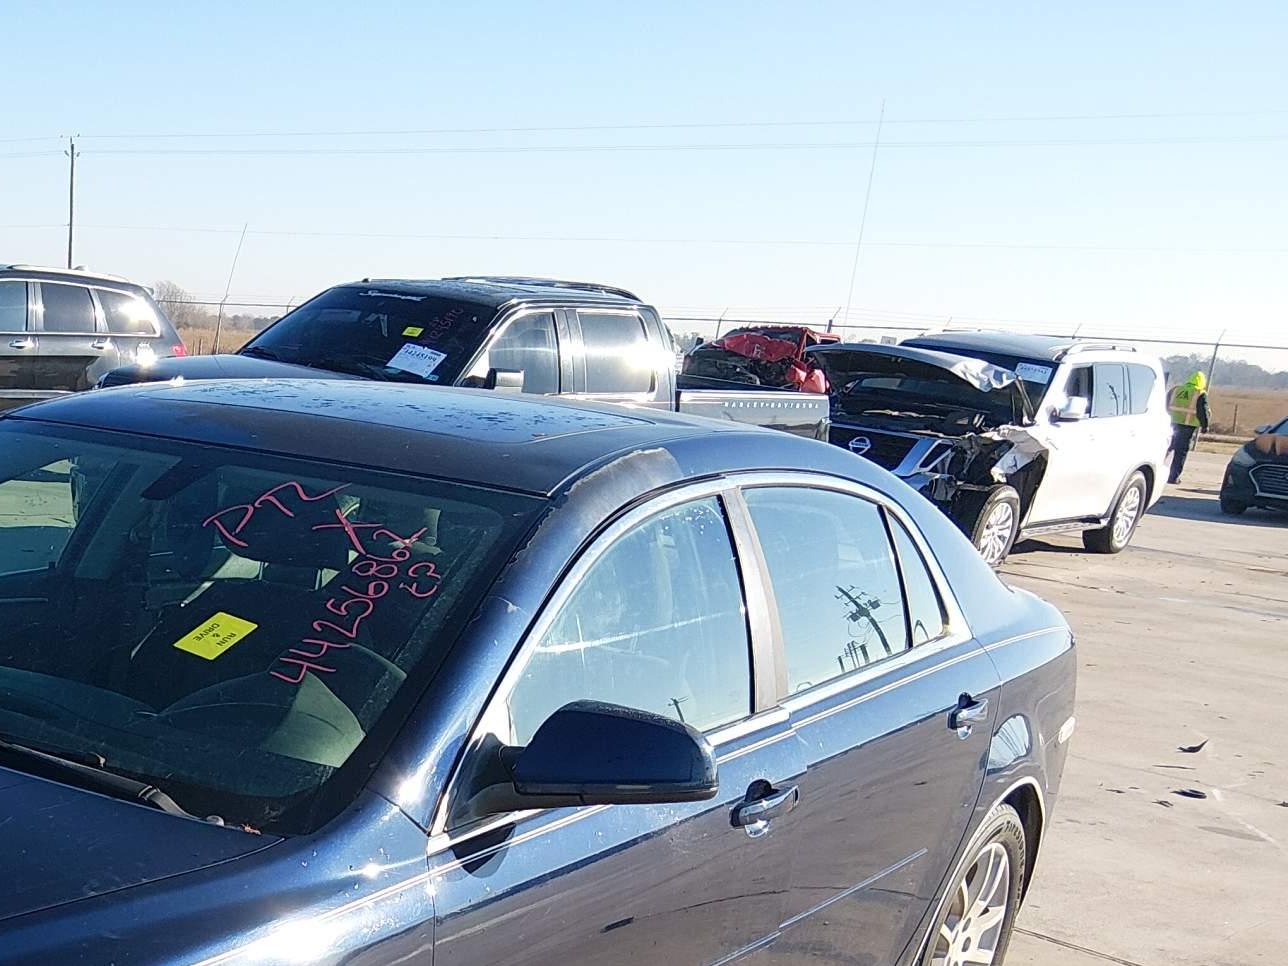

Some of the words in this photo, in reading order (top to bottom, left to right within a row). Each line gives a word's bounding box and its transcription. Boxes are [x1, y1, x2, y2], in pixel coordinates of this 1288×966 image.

[269, 526, 429, 684] 44256862
[192, 622, 221, 642] DRIVE
[215, 632, 237, 647] RUN
